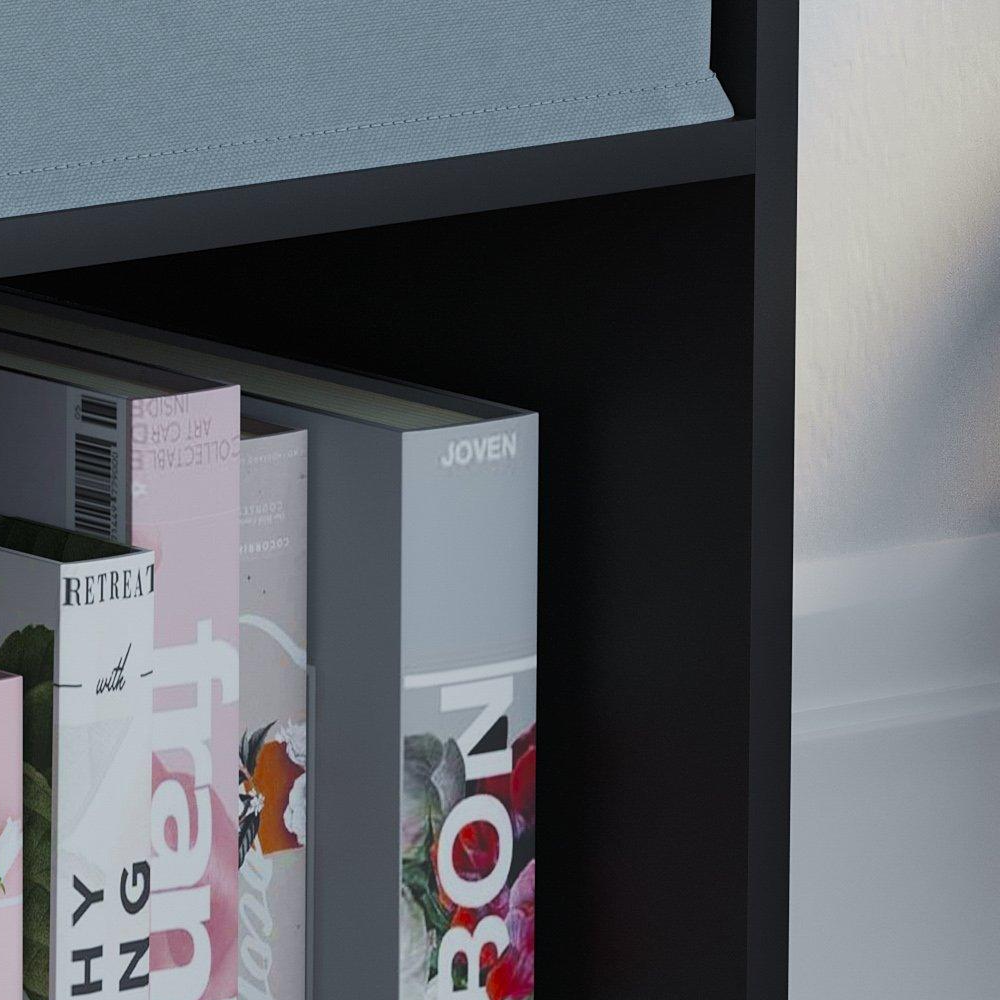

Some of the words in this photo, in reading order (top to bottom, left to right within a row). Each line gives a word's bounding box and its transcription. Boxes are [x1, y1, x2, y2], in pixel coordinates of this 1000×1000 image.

[188, 415, 212, 441] ART
[440, 430, 518, 468] JOVEN
[62, 563, 155, 606] RETREAT
[95, 642, 132, 695] with
